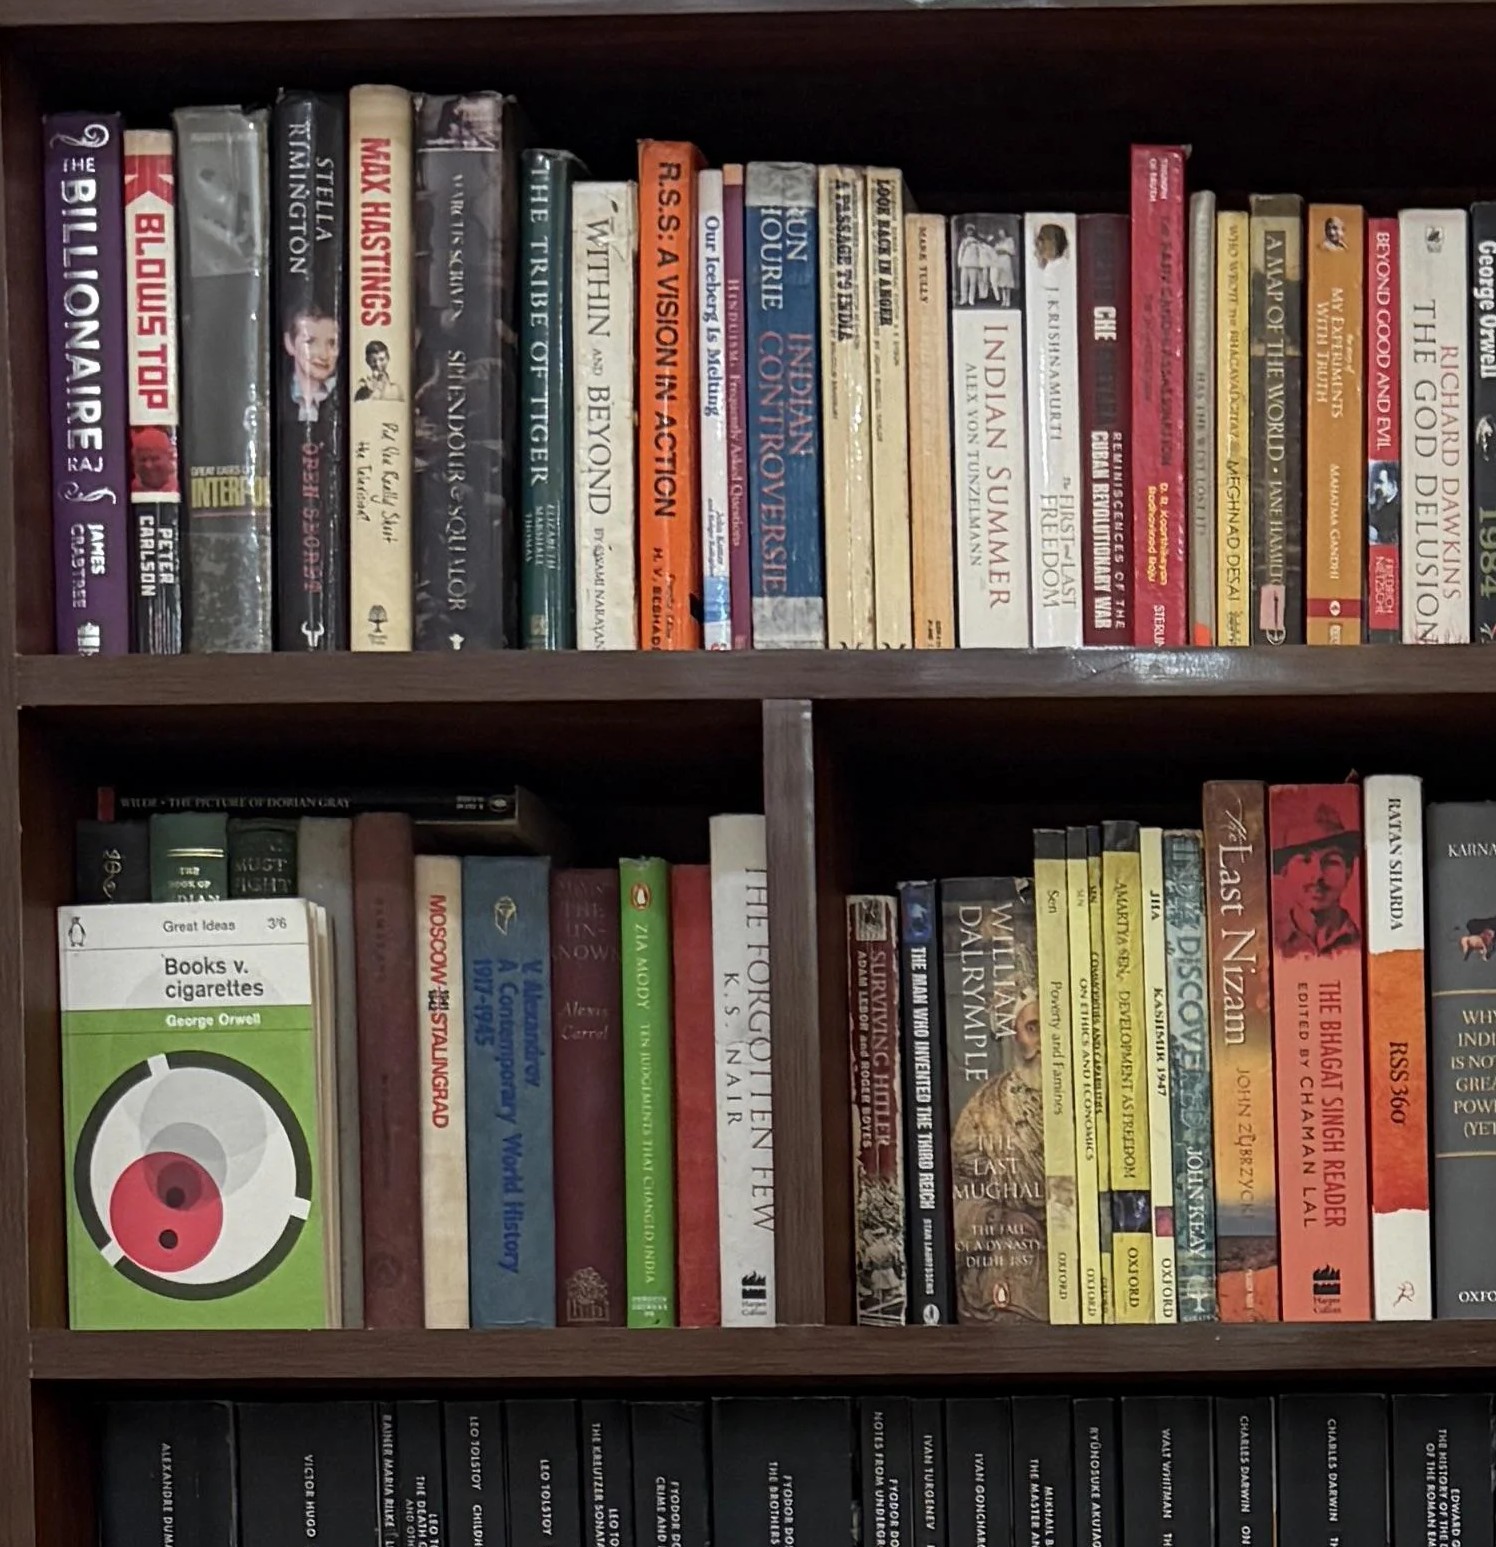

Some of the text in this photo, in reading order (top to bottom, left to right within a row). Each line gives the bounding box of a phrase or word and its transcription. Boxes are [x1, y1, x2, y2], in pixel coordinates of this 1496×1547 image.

[62, 158, 96, 173] THE
[359, 138, 391, 327] MAX HASTINGS
[61, 179, 101, 451] BILLIONAIRE
[134, 213, 170, 410] BLOWS TOP
[66, 455, 103, 474] RAJ
[983, 325, 1012, 608] INDIAN SUMMER
[163, 920, 235, 933] Great Ideas
[164, 957, 249, 976] Books v.
[165, 979, 263, 1000] cigarettes
[166, 1013, 261, 1029] George Orwell
[1451, 1056, 1463, 1071] IS
[304, 1455, 316, 1540] VICTOR HUGO
